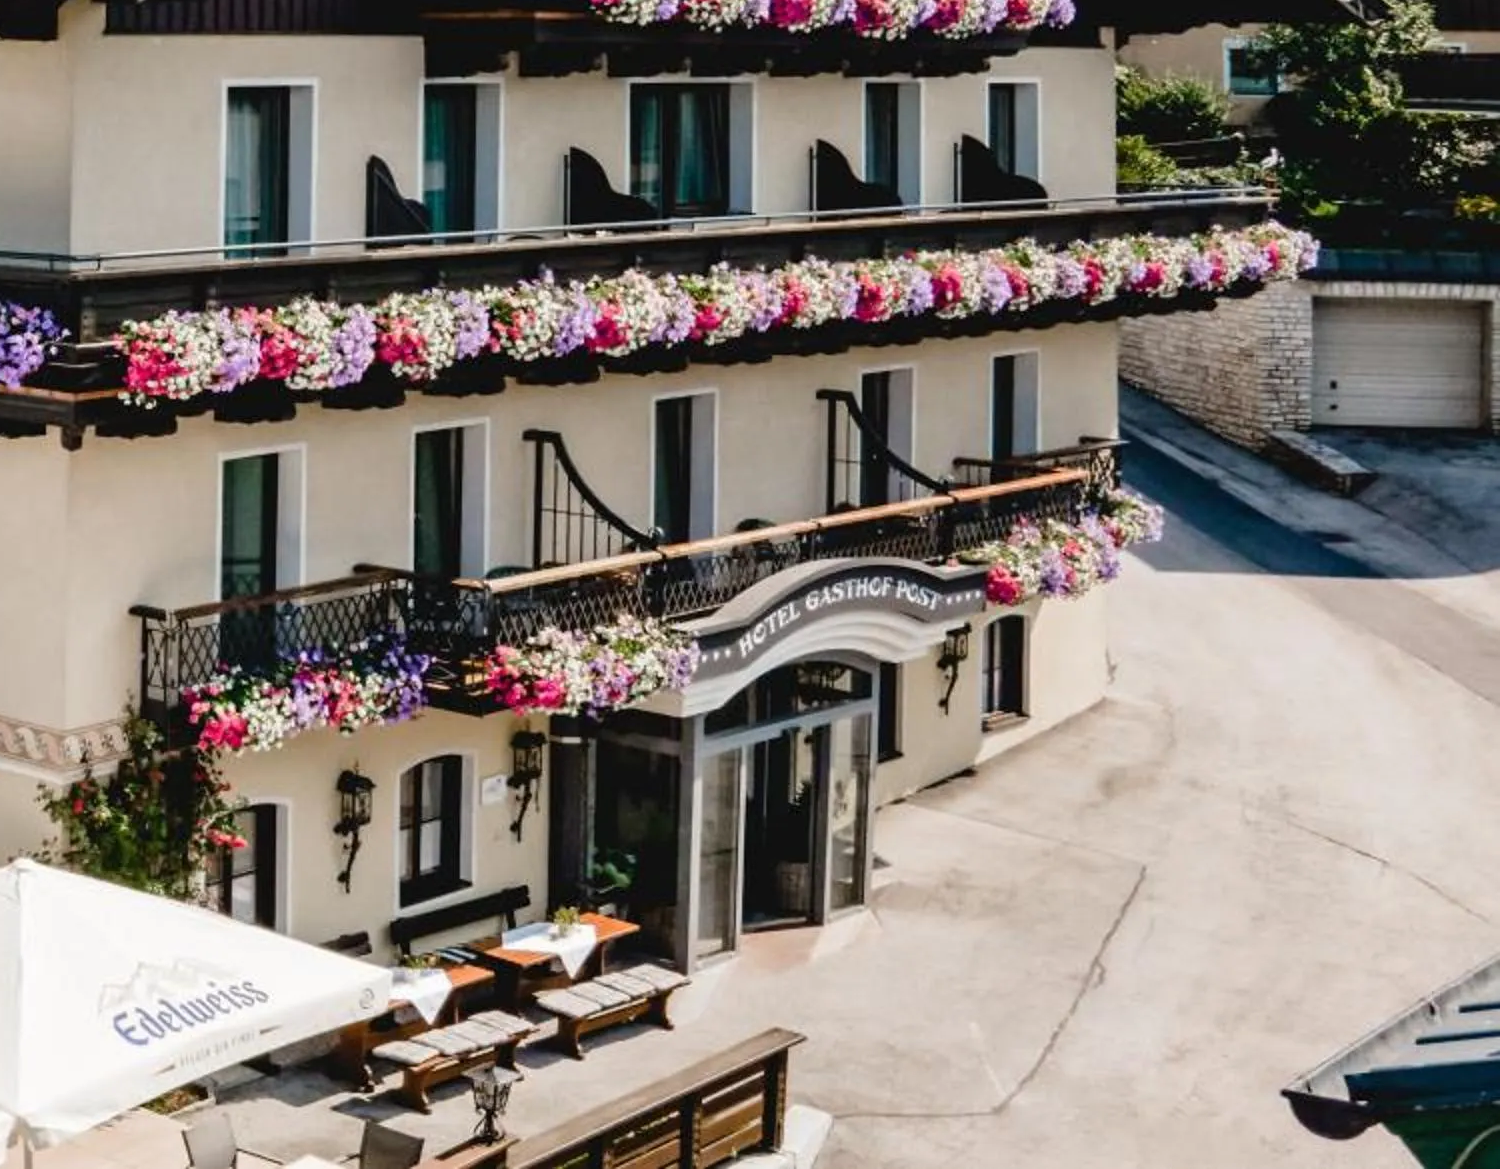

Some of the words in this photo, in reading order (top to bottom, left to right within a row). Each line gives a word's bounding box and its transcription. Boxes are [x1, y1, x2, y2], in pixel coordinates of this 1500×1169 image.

[738, 601, 801, 659] HOTEL
[805, 575, 893, 611] GASTHOF
[895, 579, 944, 611] POST
[112, 980, 270, 1046] Edelweiss
